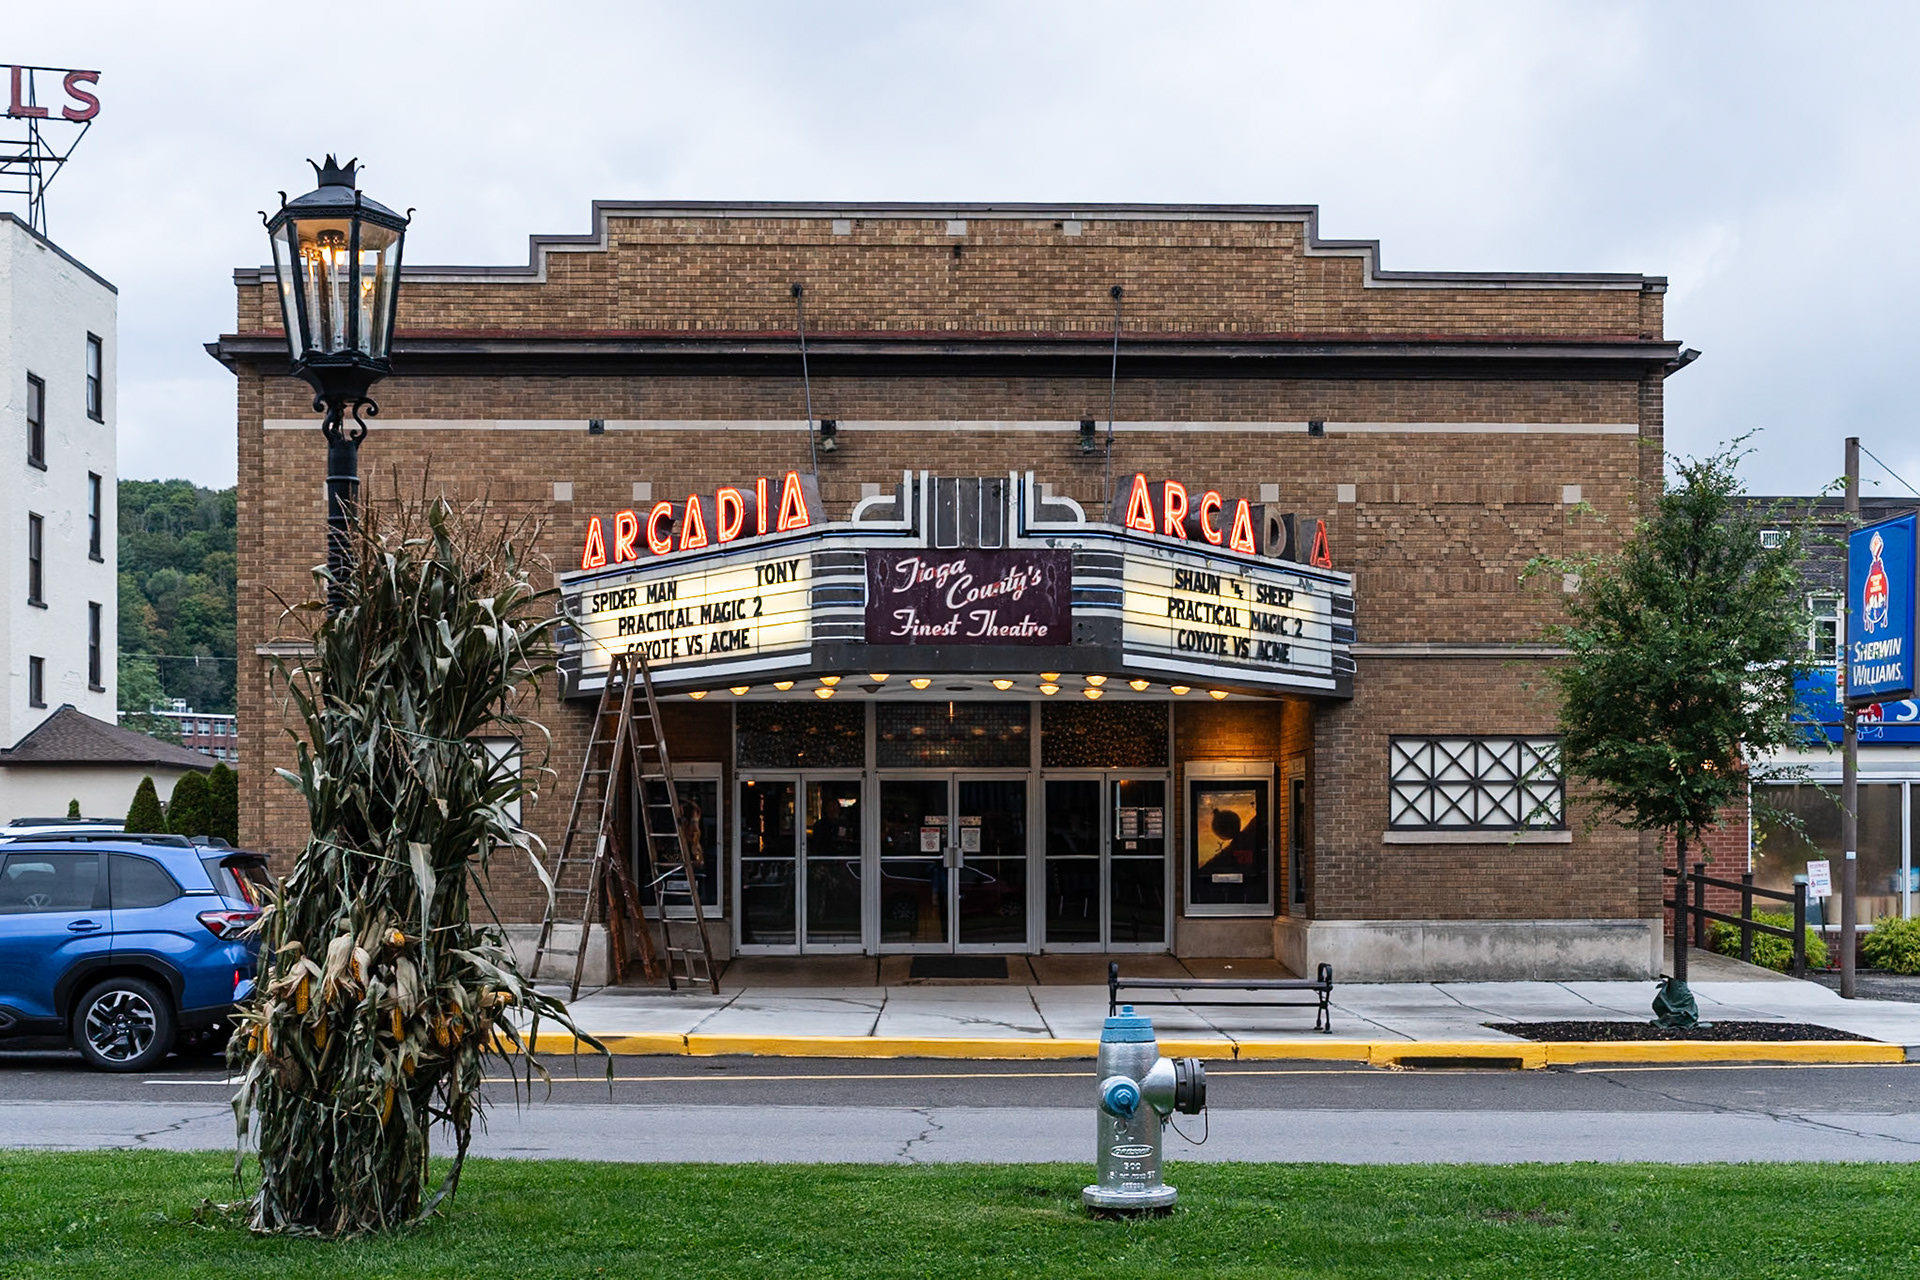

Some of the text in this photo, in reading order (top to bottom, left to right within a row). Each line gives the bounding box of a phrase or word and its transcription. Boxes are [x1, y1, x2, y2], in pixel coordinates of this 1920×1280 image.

[9, 65, 100, 121] LS
[581, 470, 810, 570] ARCADIA
[1125, 472, 1332, 569] ARCADIA
[755, 559, 800, 587] TONY
[892, 556, 967, 593] Tioga
[946, 565, 1042, 609] County's
[1174, 568, 1220, 596] SHAUN
[1256, 583, 1294, 608] SHEEP
[591, 580, 678, 614] SPIDER MAN
[618, 596, 763, 637] PRACTICAL MAGIC 2
[890, 609, 1048, 637] Finest Theatre
[1167, 597, 1303, 638] PRACTICAL MAGIC 2
[627, 628, 751, 661] COYOTE VS ACME
[1177, 629, 1291, 663] COYOTE VS ACME
[1853, 637, 1902, 663] SHERWIN
[1853, 662, 1902, 687] WILLIAMS
